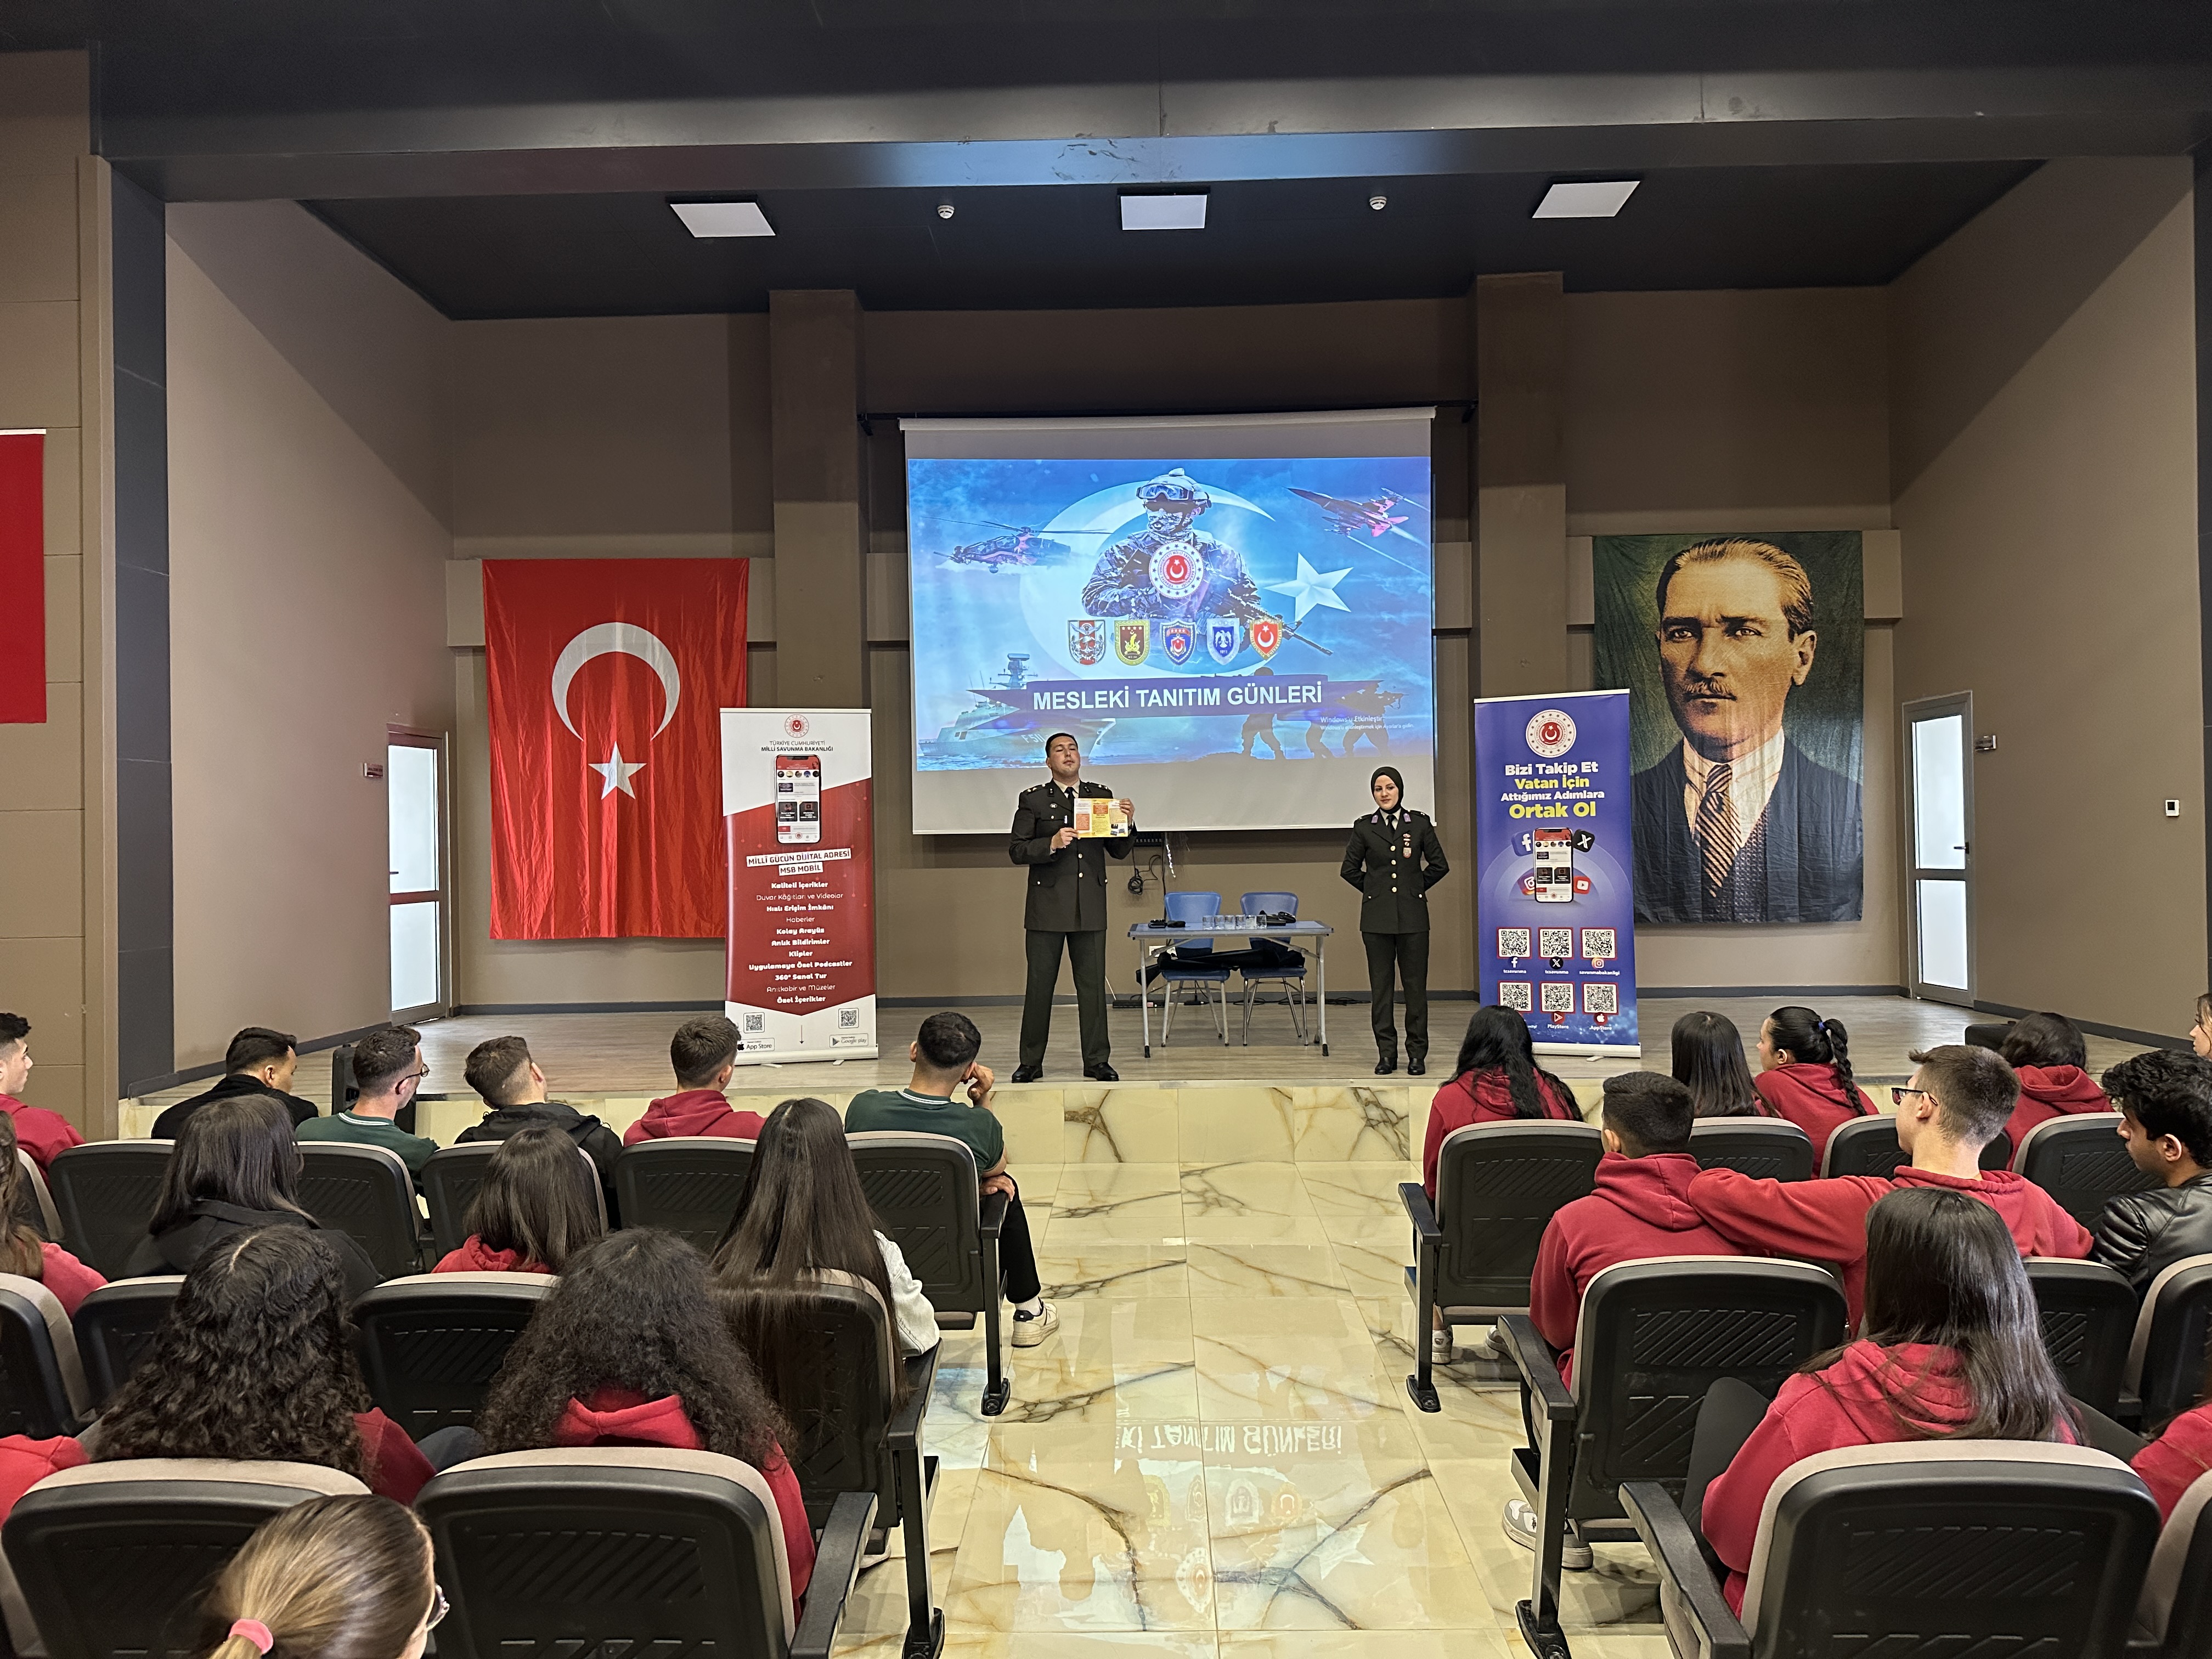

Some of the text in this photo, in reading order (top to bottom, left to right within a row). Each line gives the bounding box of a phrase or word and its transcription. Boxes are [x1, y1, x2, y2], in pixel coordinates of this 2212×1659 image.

[1034, 681, 1322, 710] MESLEKİ TANITIM GÜNLERİ
[1353, 715, 1384, 723] Etkinleştir
[1505, 761, 1599, 776] Bizi Takip Et
[1514, 774, 1590, 789] Vatan İçin
[1500, 790, 1605, 802] Attığımız Adımlara
[1509, 801, 1596, 819] Ortak Ol
[770, 854, 794, 863] GÜCÜN
[796, 852, 823, 861] DİJİTAL
[823, 849, 850, 859] ADRESİ
[798, 863, 821, 872] MOBİL
[784, 904, 806, 912] Erişim
[748, 963, 795, 971] Uygulamaya
[794, 995, 826, 1004] İçerikler
